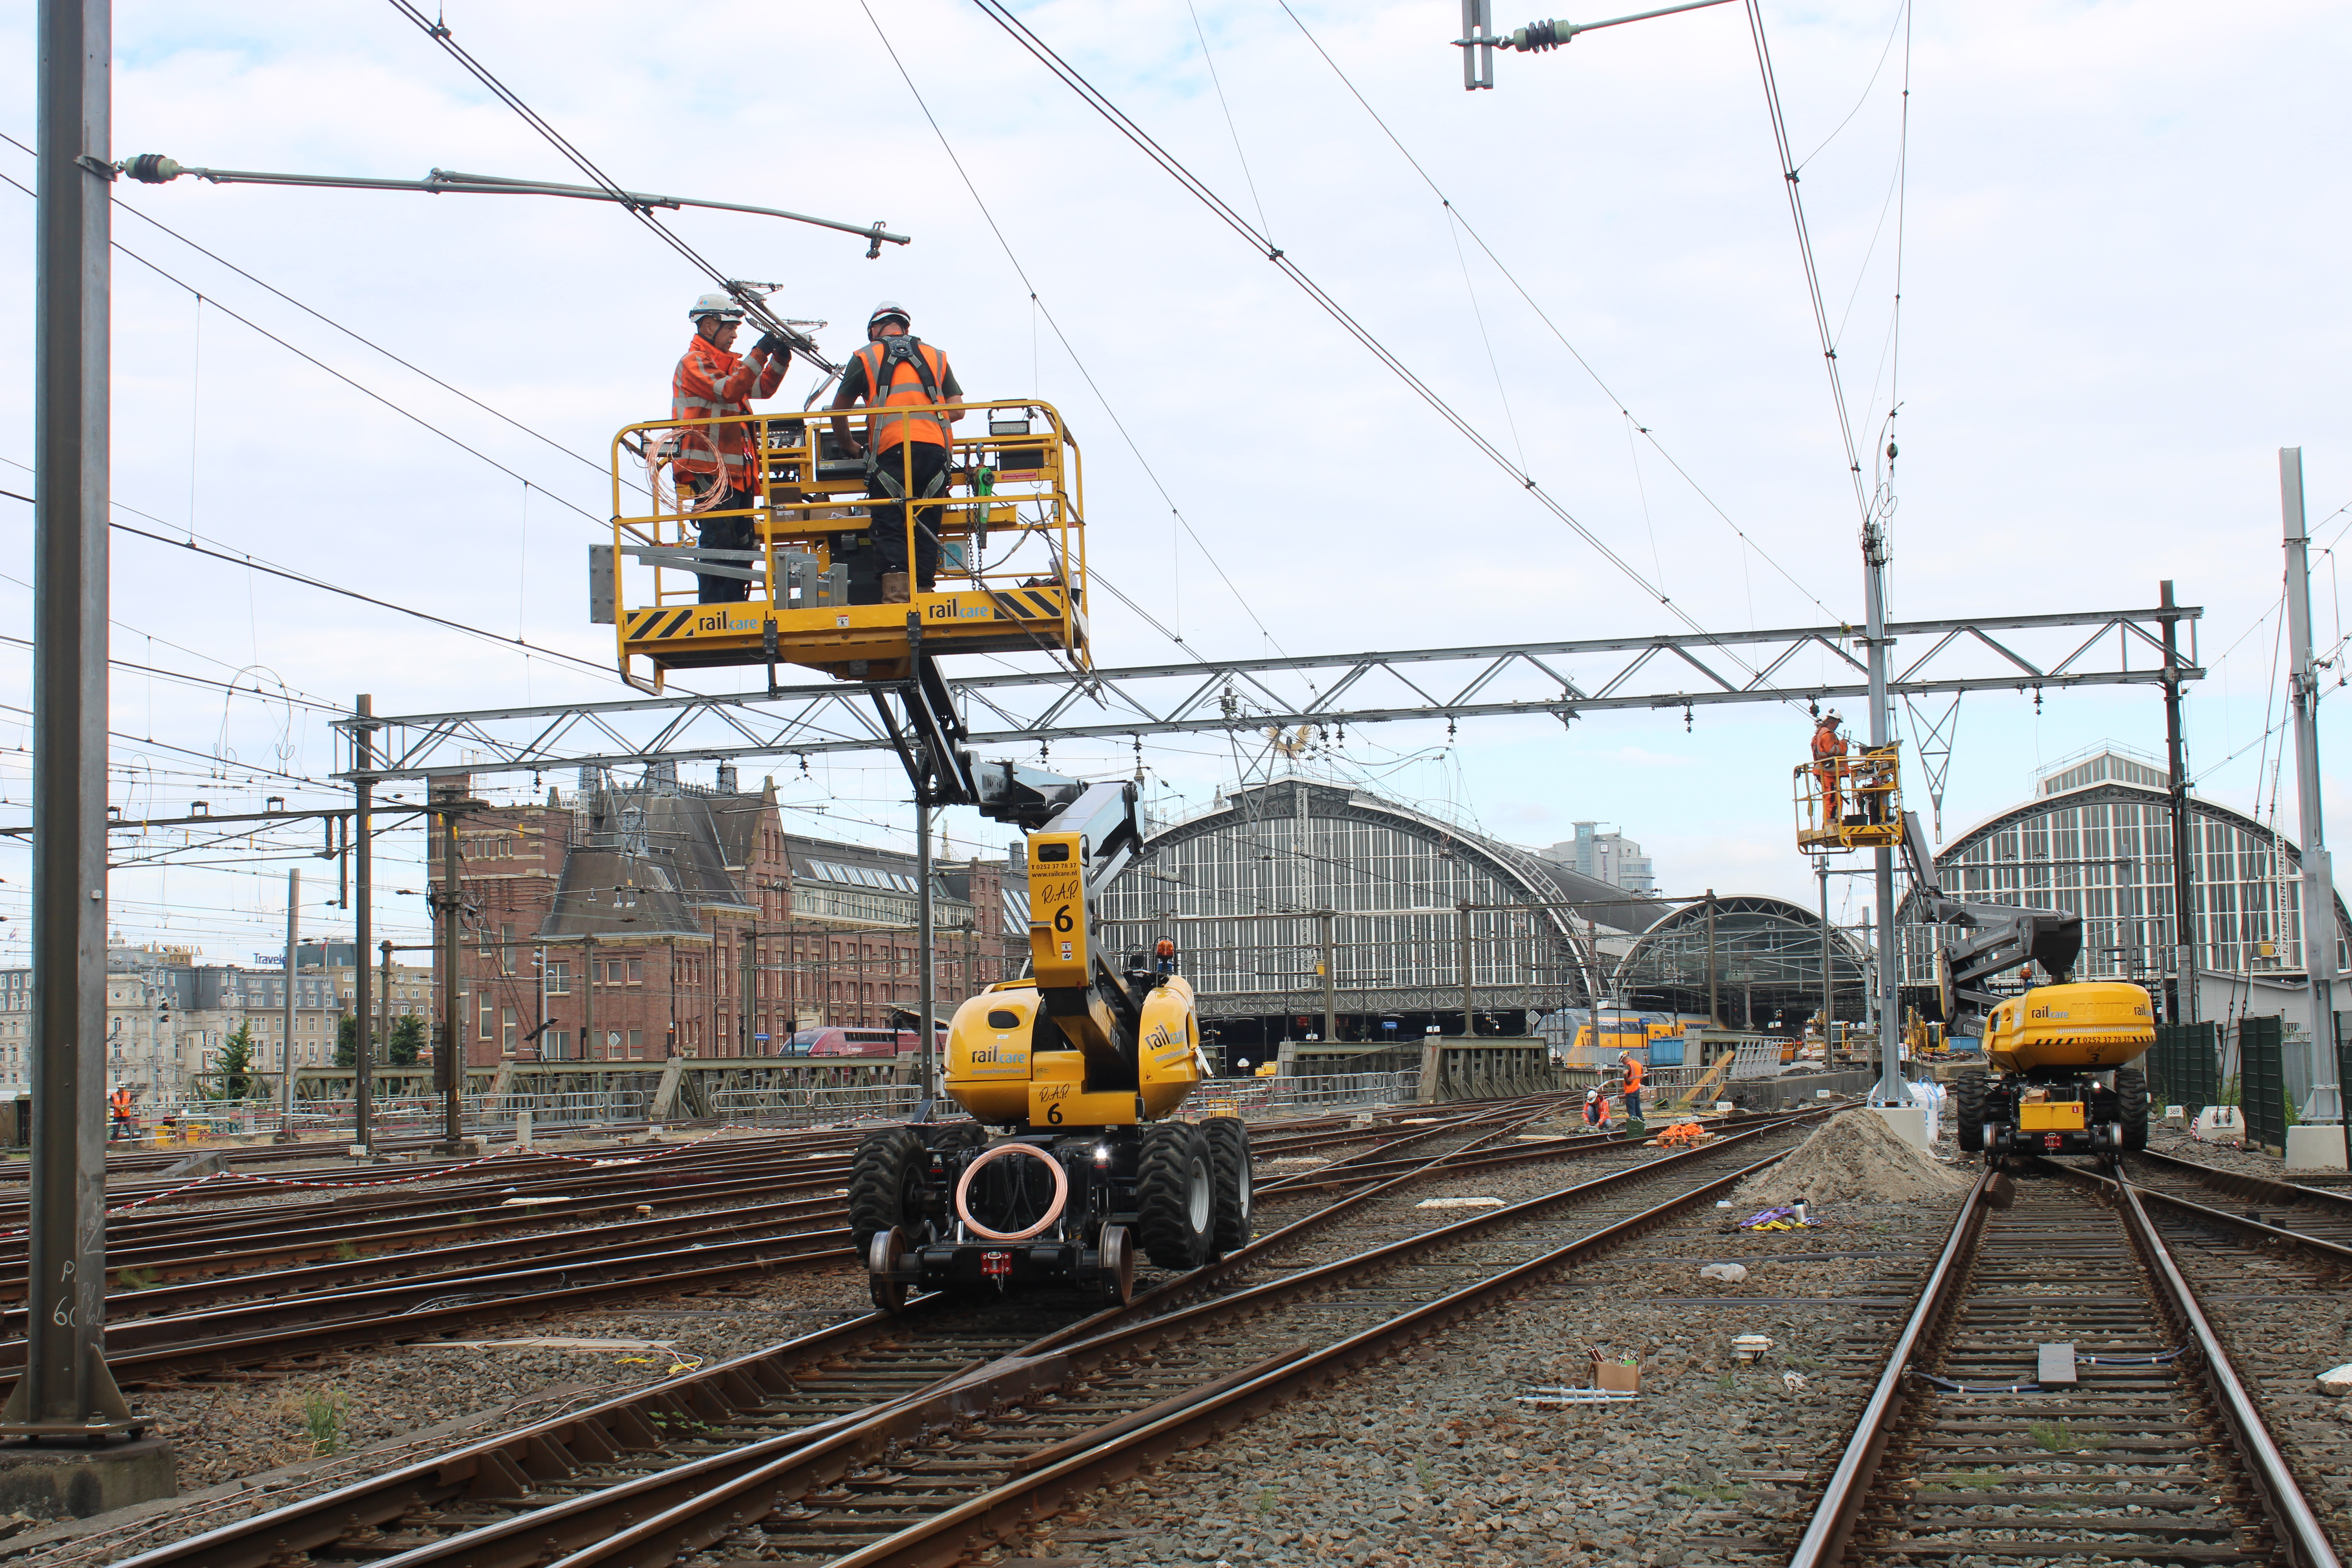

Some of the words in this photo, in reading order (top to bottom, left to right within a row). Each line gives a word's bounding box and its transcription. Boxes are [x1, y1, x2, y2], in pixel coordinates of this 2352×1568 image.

[1054, 904, 1073, 933] 6
[143, 944, 203, 956] VICTORIA
[2070, 1002, 2133, 1016] MANITOU
[1963, 1024, 1966, 1033] T
[1966, 1025, 1976, 1036] 0252
[1977, 1028, 1983, 1037] 37
[2056, 1025, 2141, 1034] spoormachineverhuur.nl
[1111, 1026, 1115, 1046] 78
[1116, 1033, 1120, 1051] 37
[2087, 1053, 2100, 1063] 3
[1047, 1102, 1063, 1125] 6
